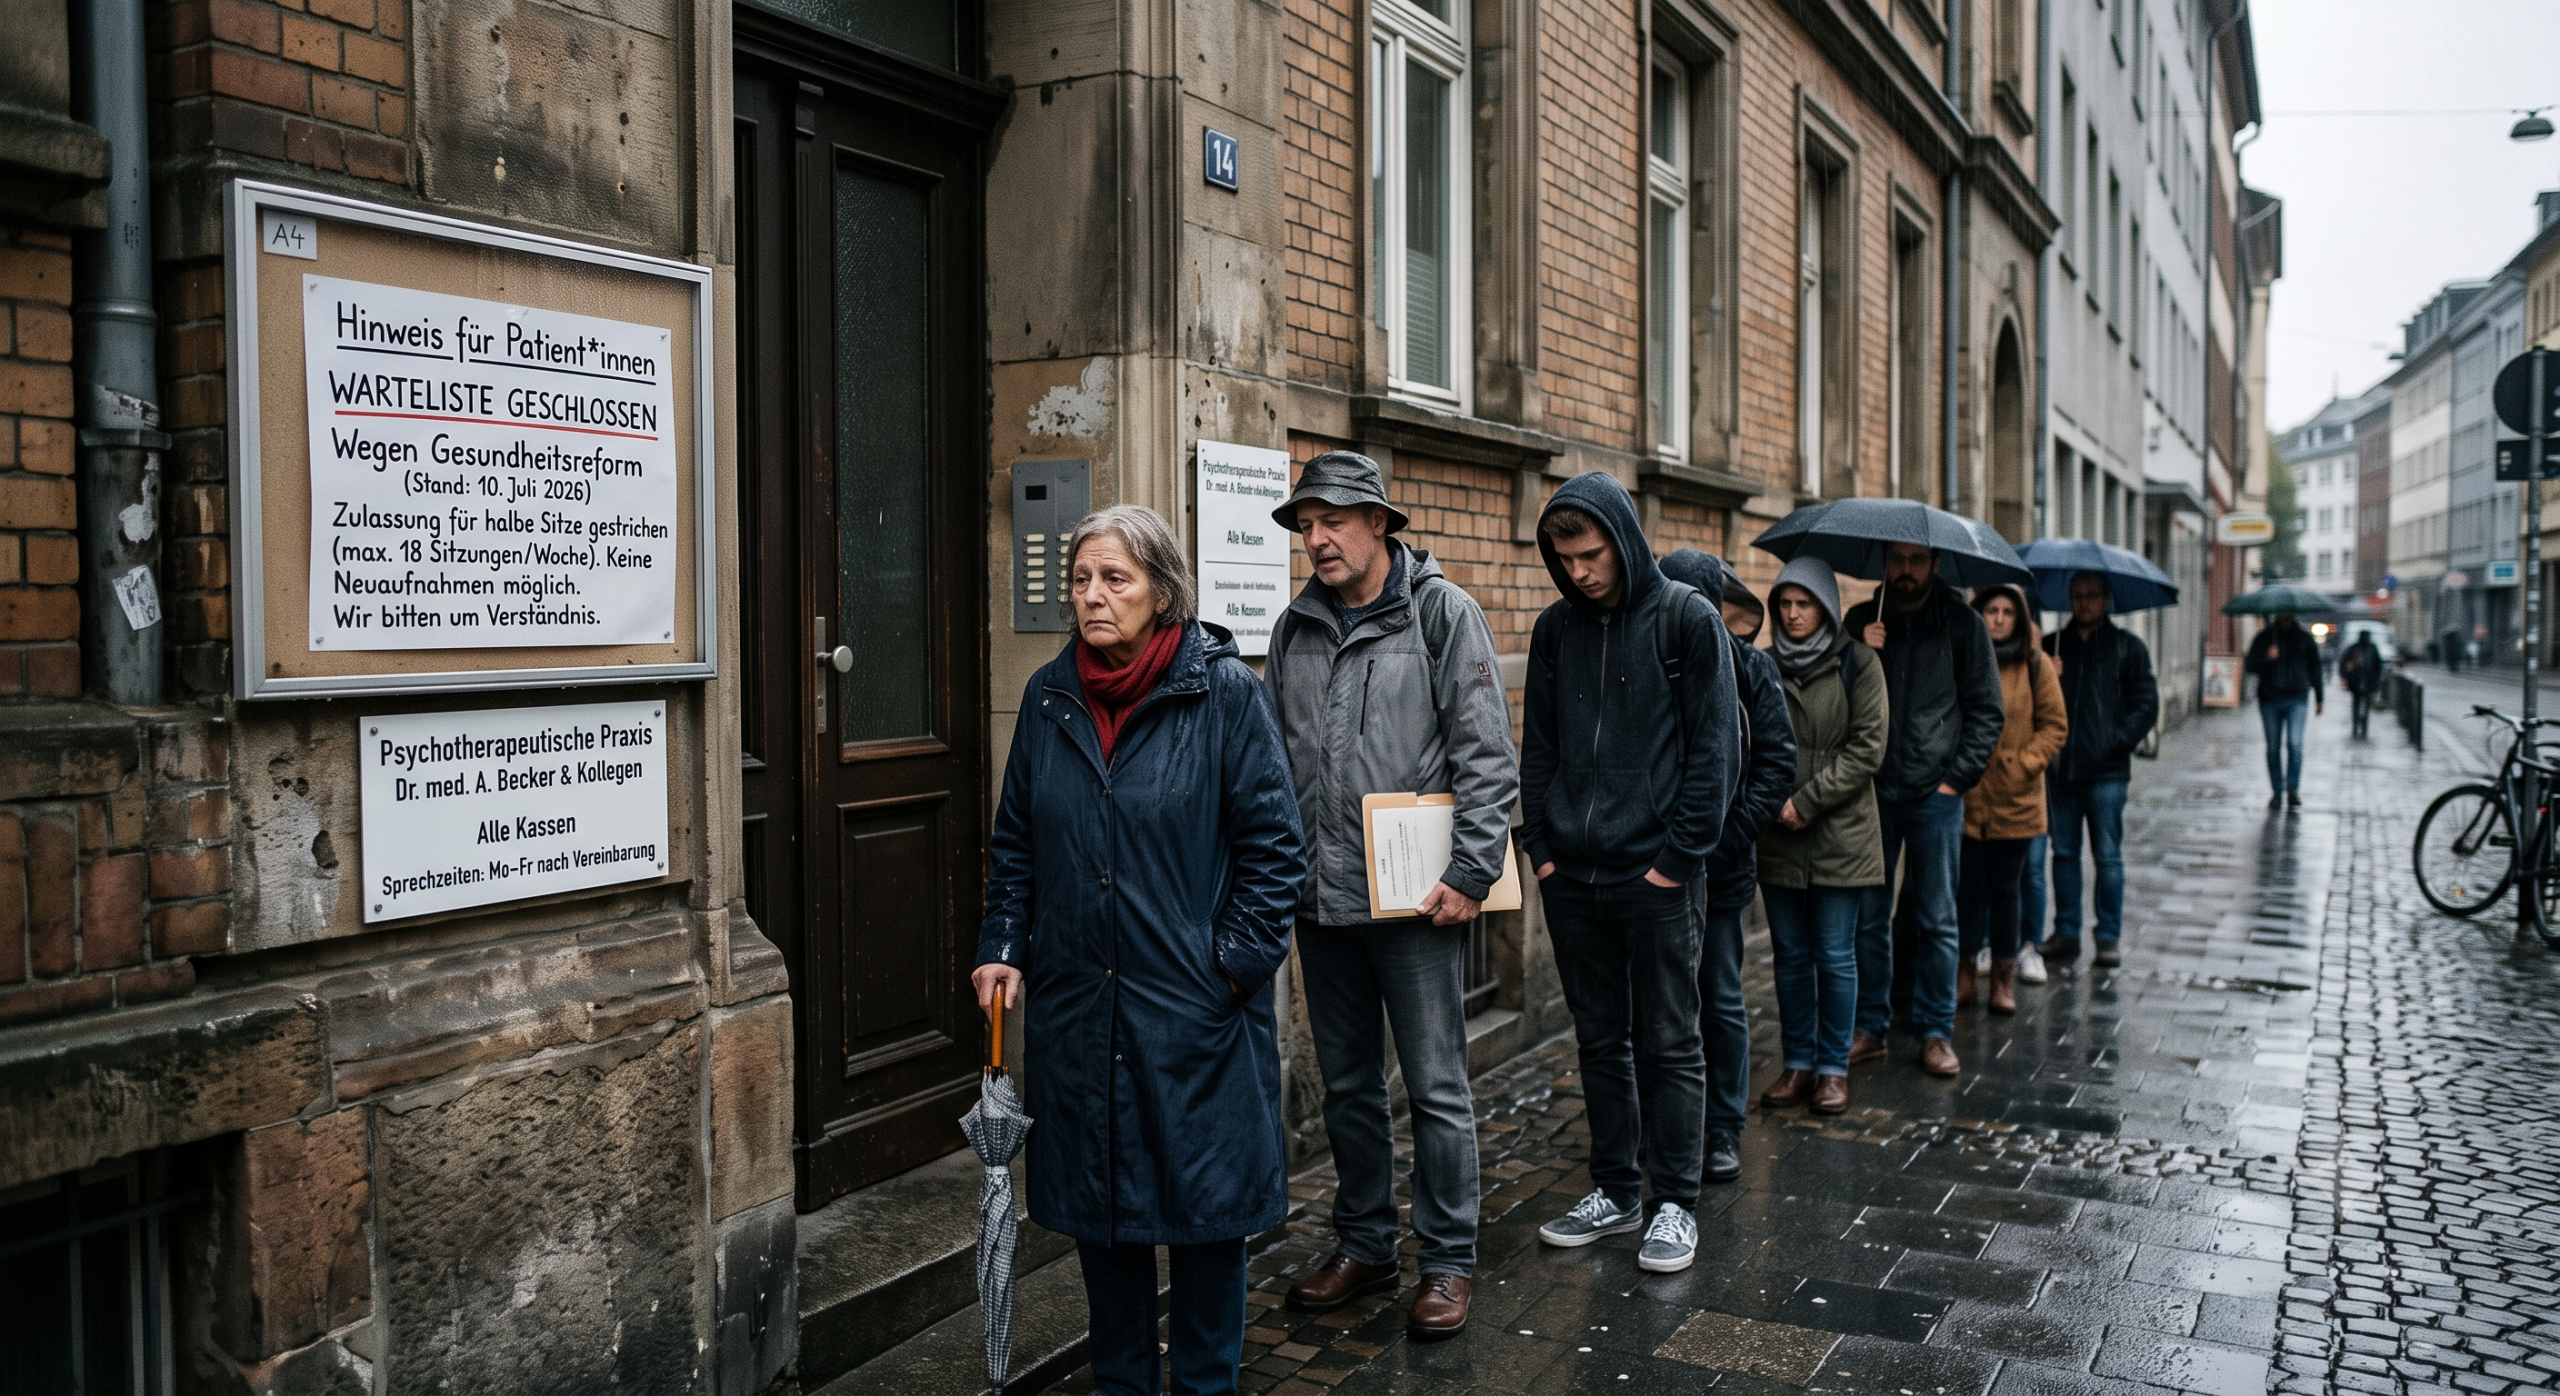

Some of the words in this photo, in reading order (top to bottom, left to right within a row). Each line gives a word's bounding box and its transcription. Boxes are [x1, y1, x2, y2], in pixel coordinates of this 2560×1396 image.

[1213, 139, 1234, 180] 14
[272, 223, 305, 250] A4
[336, 300, 444, 350] Hinweis
[455, 315, 495, 364] für
[328, 369, 494, 416] WARTELISTE
[507, 387, 657, 433] GESCHLOSSEN
[330, 426, 418, 473] Wegen
[431, 432, 643, 484] Gesundheitsreform
[403, 469, 471, 497] (Stand:
[477, 475, 504, 497] 10.
[506, 476, 537, 504] Juli
[543, 478, 592, 506] 2026)
[332, 501, 441, 539] Zulassung
[448, 506, 479, 536] für
[485, 508, 535, 534] halbe
[540, 510, 583, 536] Sitze
[588, 514, 668, 544] gestrichen
[1227, 530, 1239, 545] Alle
[332, 535, 393, 567] (max.
[399, 539, 423, 563] 18
[429, 539, 601, 572] Sitzungen/Woche).
[606, 545, 653, 569] Keine
[334, 569, 495, 596] Neuaufnahmen
[503, 573, 581, 604] möglich.
[333, 603, 373, 629] Wir
[381, 603, 442, 629] bitten
[449, 611, 480, 627] um
[486, 602, 601, 627] Verständnis.
[1226, 602, 1239, 616] Alle
[380, 725, 595, 772] Psychotherapeutische
[600, 721, 653, 749] Praxis
[395, 777, 420, 802] Dr.
[425, 772, 470, 799] med.
[474, 770, 492, 794] A.
[497, 766, 557, 792] Becker
[560, 764, 573, 786] &
[577, 759, 643, 786] Kollegen
[476, 819, 511, 845] Alle
[515, 815, 576, 840] Kassen
[382, 865, 485, 901] Sprechzeiten:
[537, 851, 569, 874] nach
[572, 843, 656, 868] Vereinbarung
